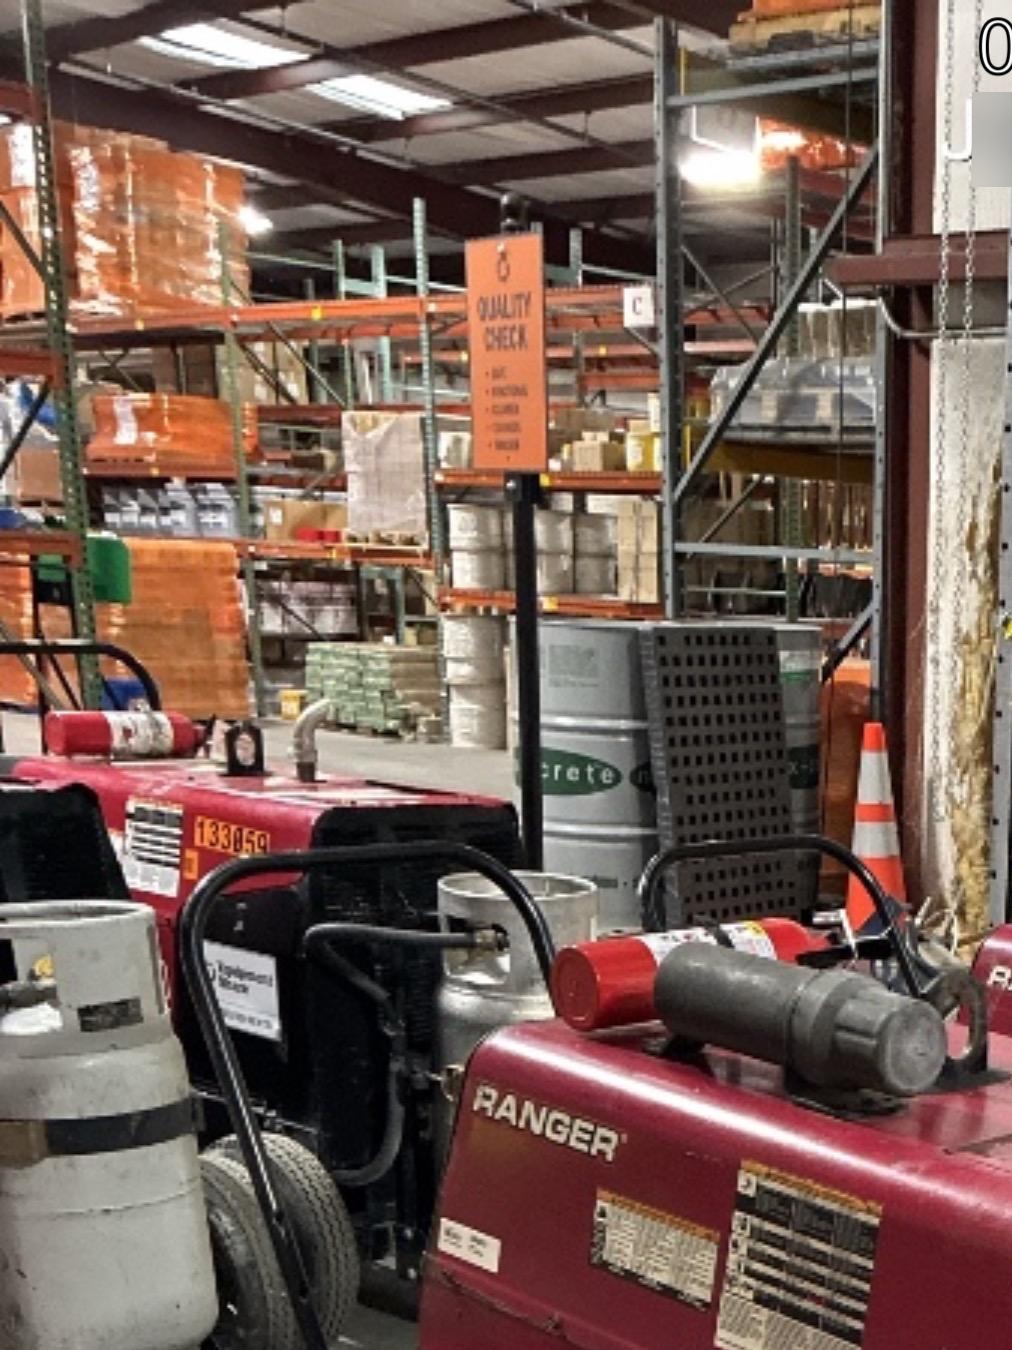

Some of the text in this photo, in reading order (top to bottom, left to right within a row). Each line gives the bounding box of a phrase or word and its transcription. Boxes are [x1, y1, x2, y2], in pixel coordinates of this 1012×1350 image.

[476, 291, 532, 321] QUALITY
[483, 324, 529, 352] CHECK
[472, 1084, 620, 1163] RANGER
